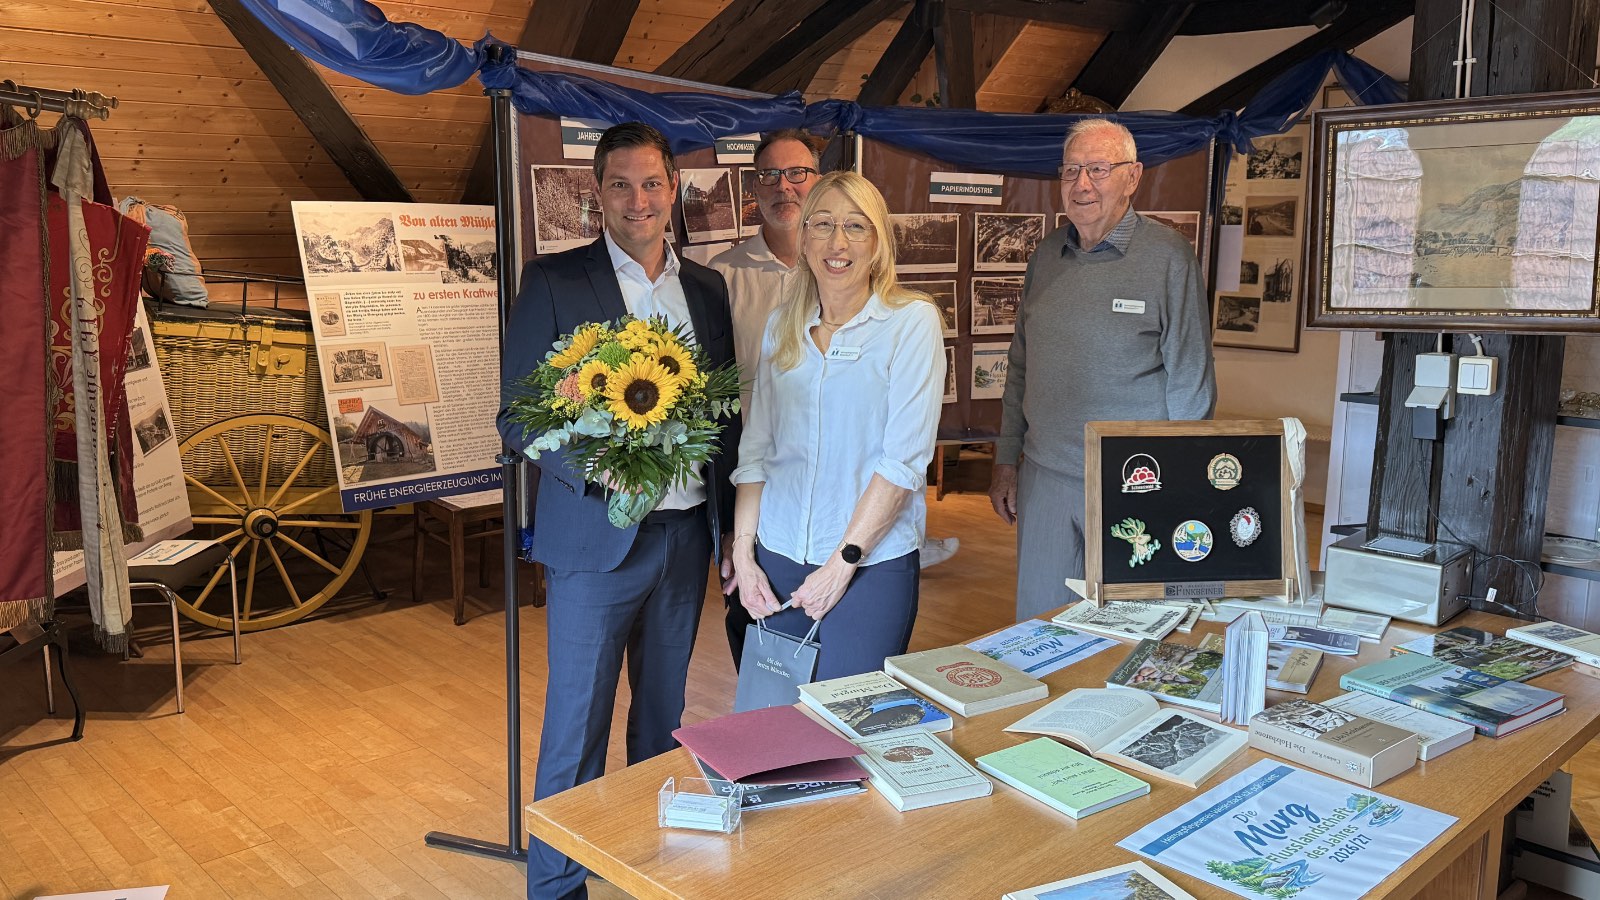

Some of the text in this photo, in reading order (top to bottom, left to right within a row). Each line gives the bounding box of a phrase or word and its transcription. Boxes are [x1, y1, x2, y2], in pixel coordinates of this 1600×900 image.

[941, 185, 993, 194] PAPIERINDUSTRIE
[398, 214, 427, 227] Von
[429, 214, 458, 228] alten
[413, 292, 426, 301] zu
[428, 289, 461, 300] ersten
[353, 472, 503, 503] FRÜHE ENERGIEERZEUGUNG IM
[1176, 584, 1223, 596] FINKBEINER
[1019, 636, 1064, 657] Murg
[1254, 730, 1306, 754] Die Holzbarone
[1232, 809, 1258, 824] Die
[1233, 802, 1321, 857] Murg
[1265, 806, 1355, 864] Flusslandschaft
[1306, 824, 1359, 860] des Jahres
[1328, 833, 1373, 864] 2026/27
